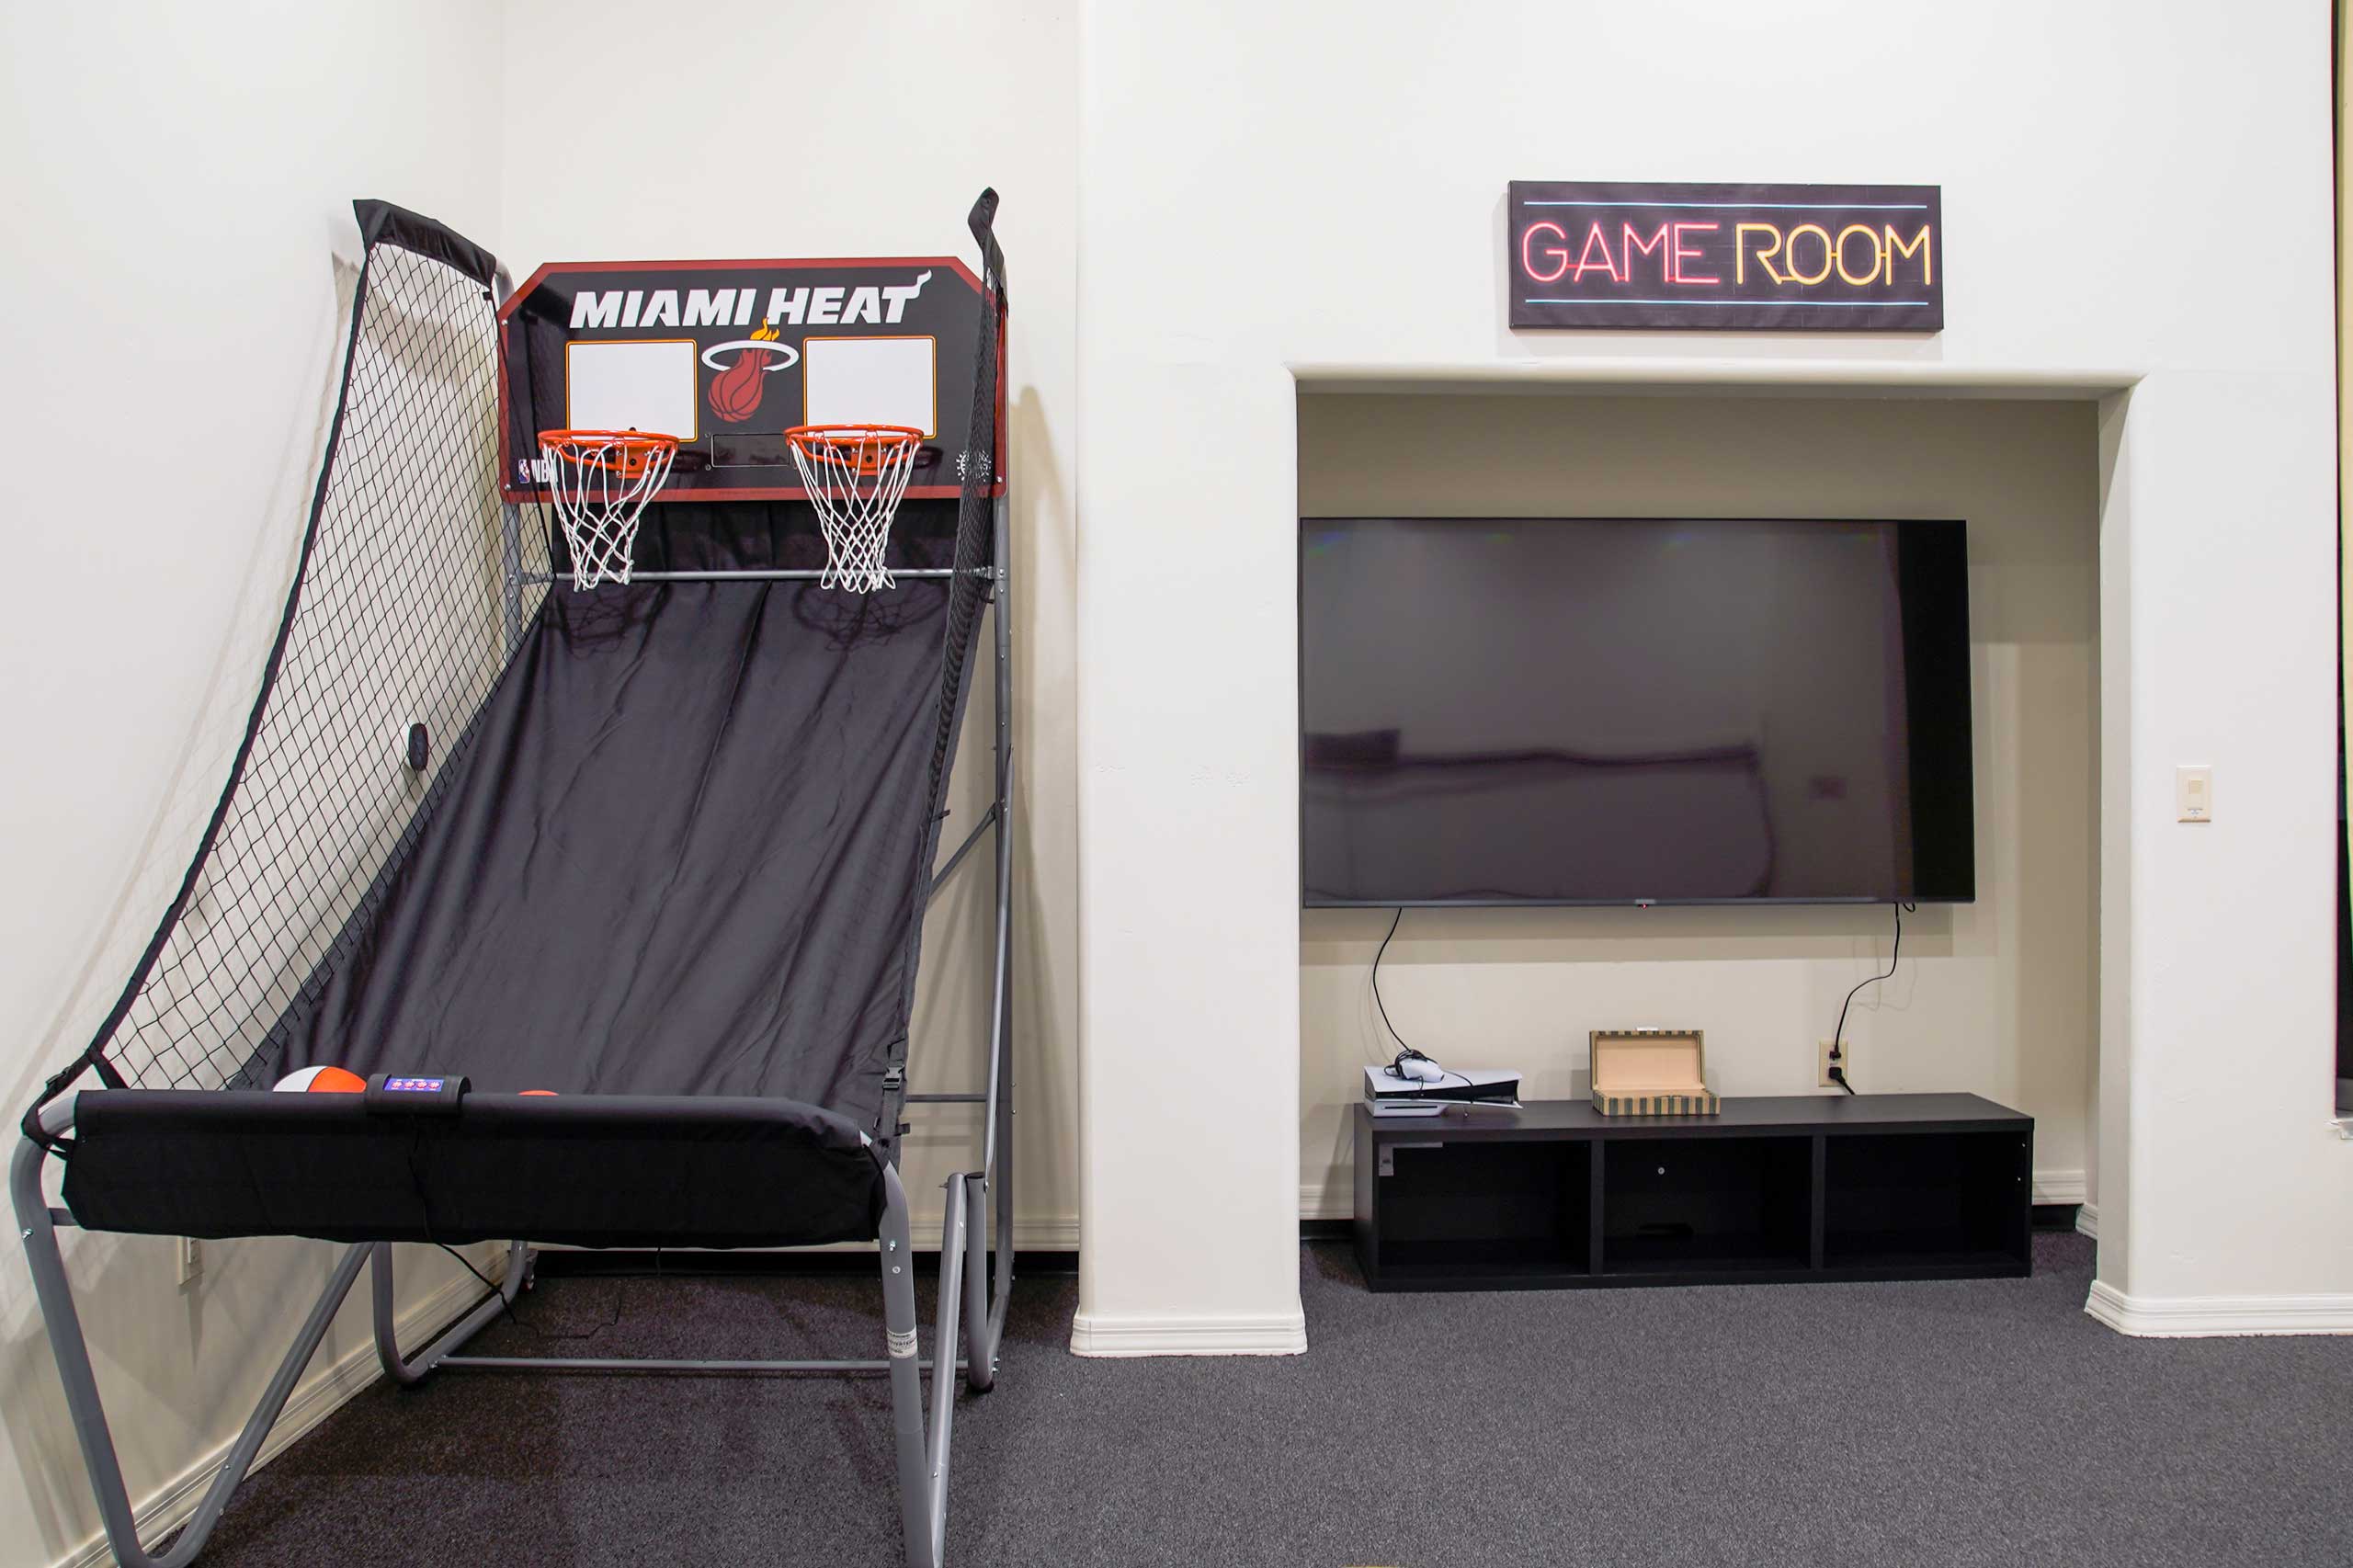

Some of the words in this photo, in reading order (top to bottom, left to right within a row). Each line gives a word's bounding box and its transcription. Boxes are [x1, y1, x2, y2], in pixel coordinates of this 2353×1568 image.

[1522, 222, 1720, 284] GAME
[1735, 223, 1931, 287] ROOM
[569, 289, 757, 328] MIAMI
[767, 269, 932, 324] HEAT
